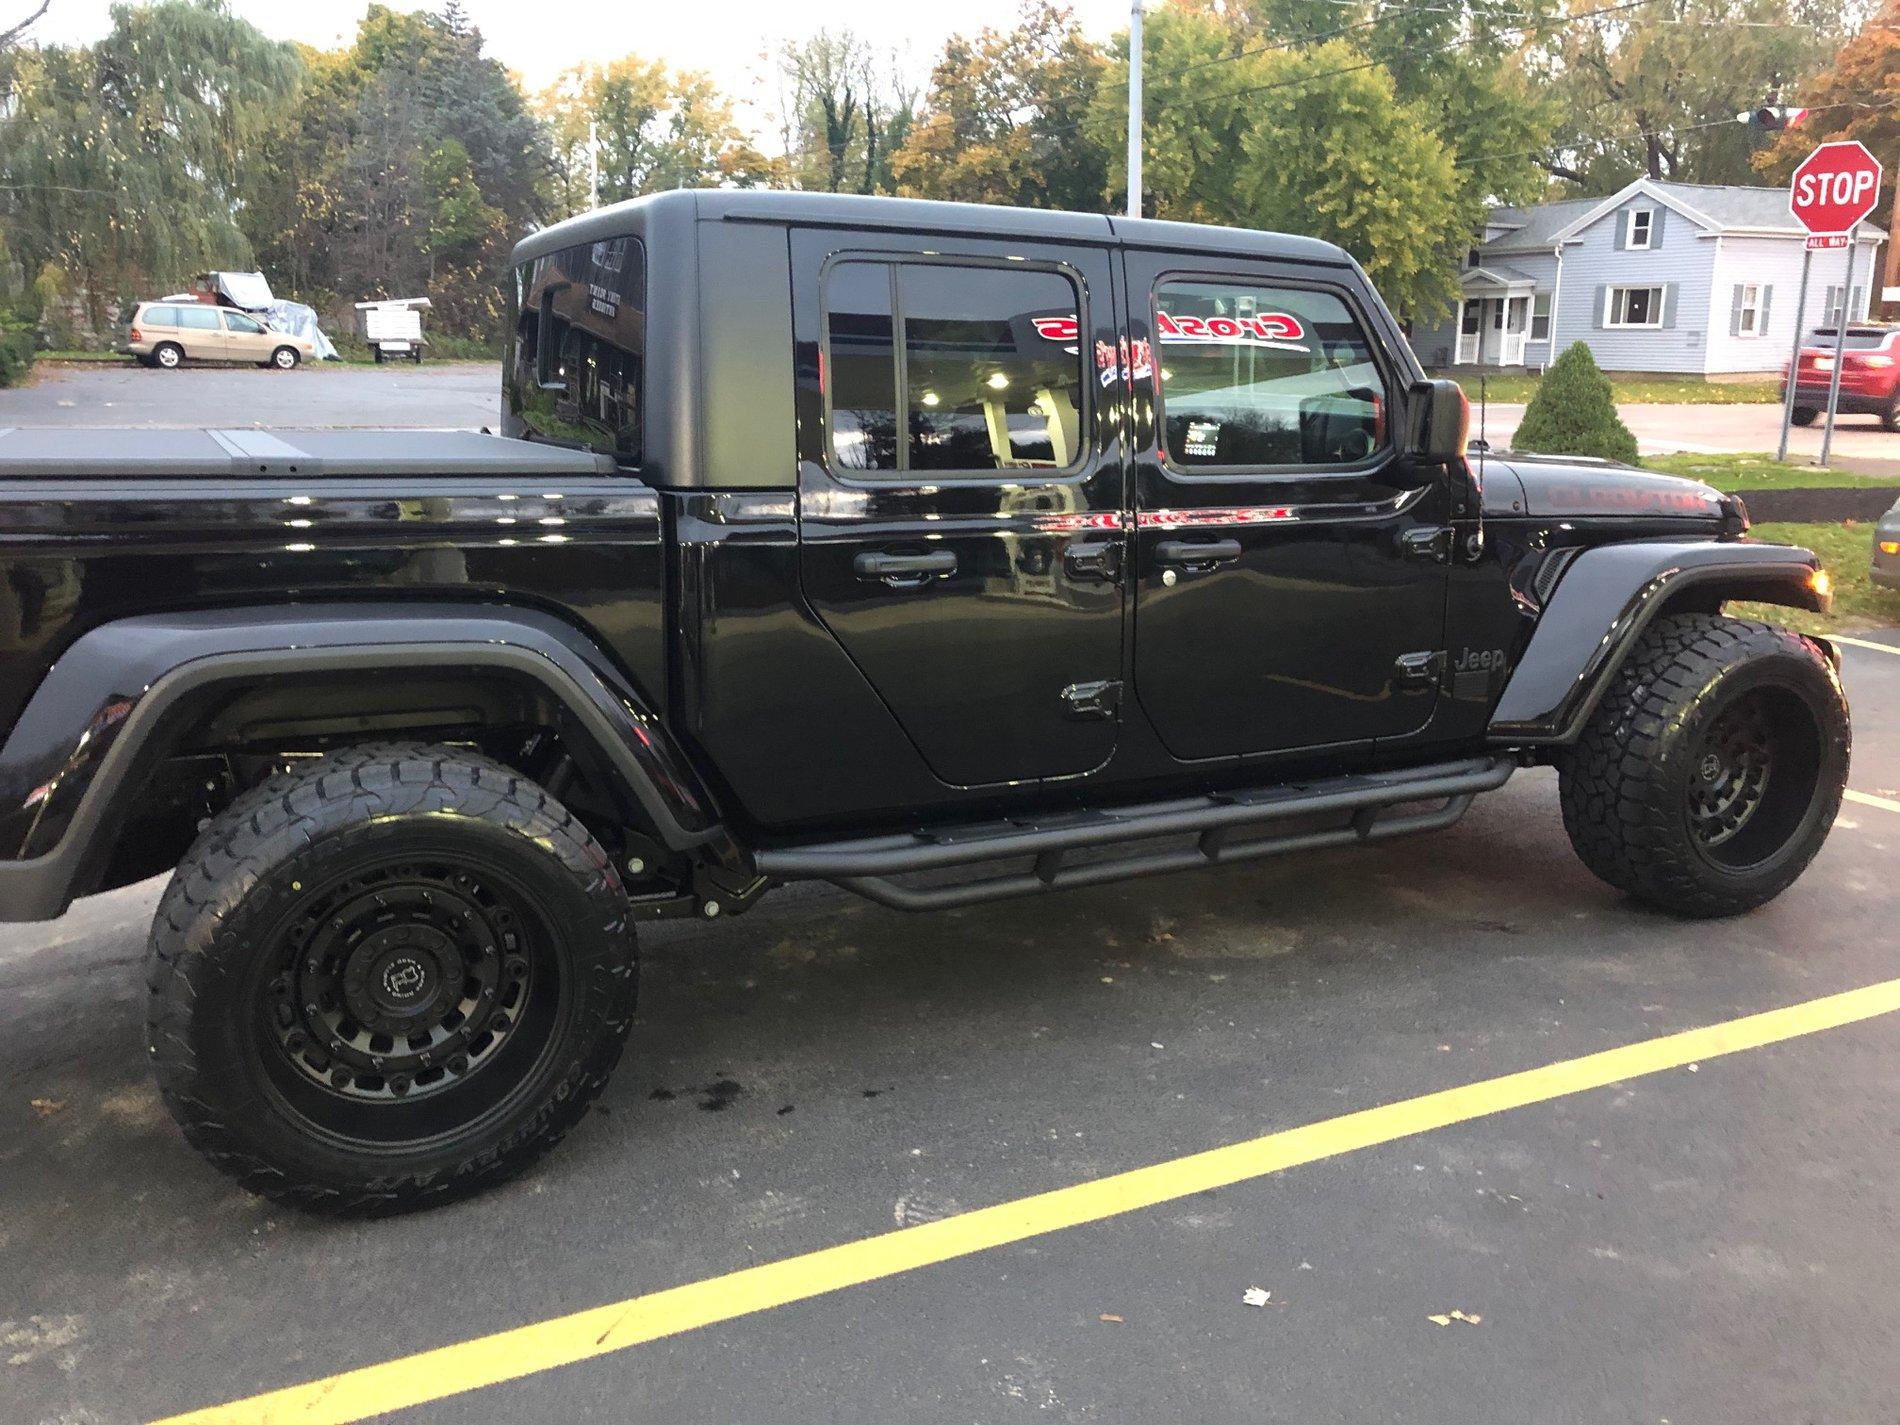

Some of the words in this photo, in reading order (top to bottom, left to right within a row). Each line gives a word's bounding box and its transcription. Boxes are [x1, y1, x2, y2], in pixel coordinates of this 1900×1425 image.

[1797, 171, 1873, 207] STOP
[1809, 238, 1824, 248] ALL
[1829, 236, 1845, 247] WAY
[1455, 647, 1505, 671] Jeep
